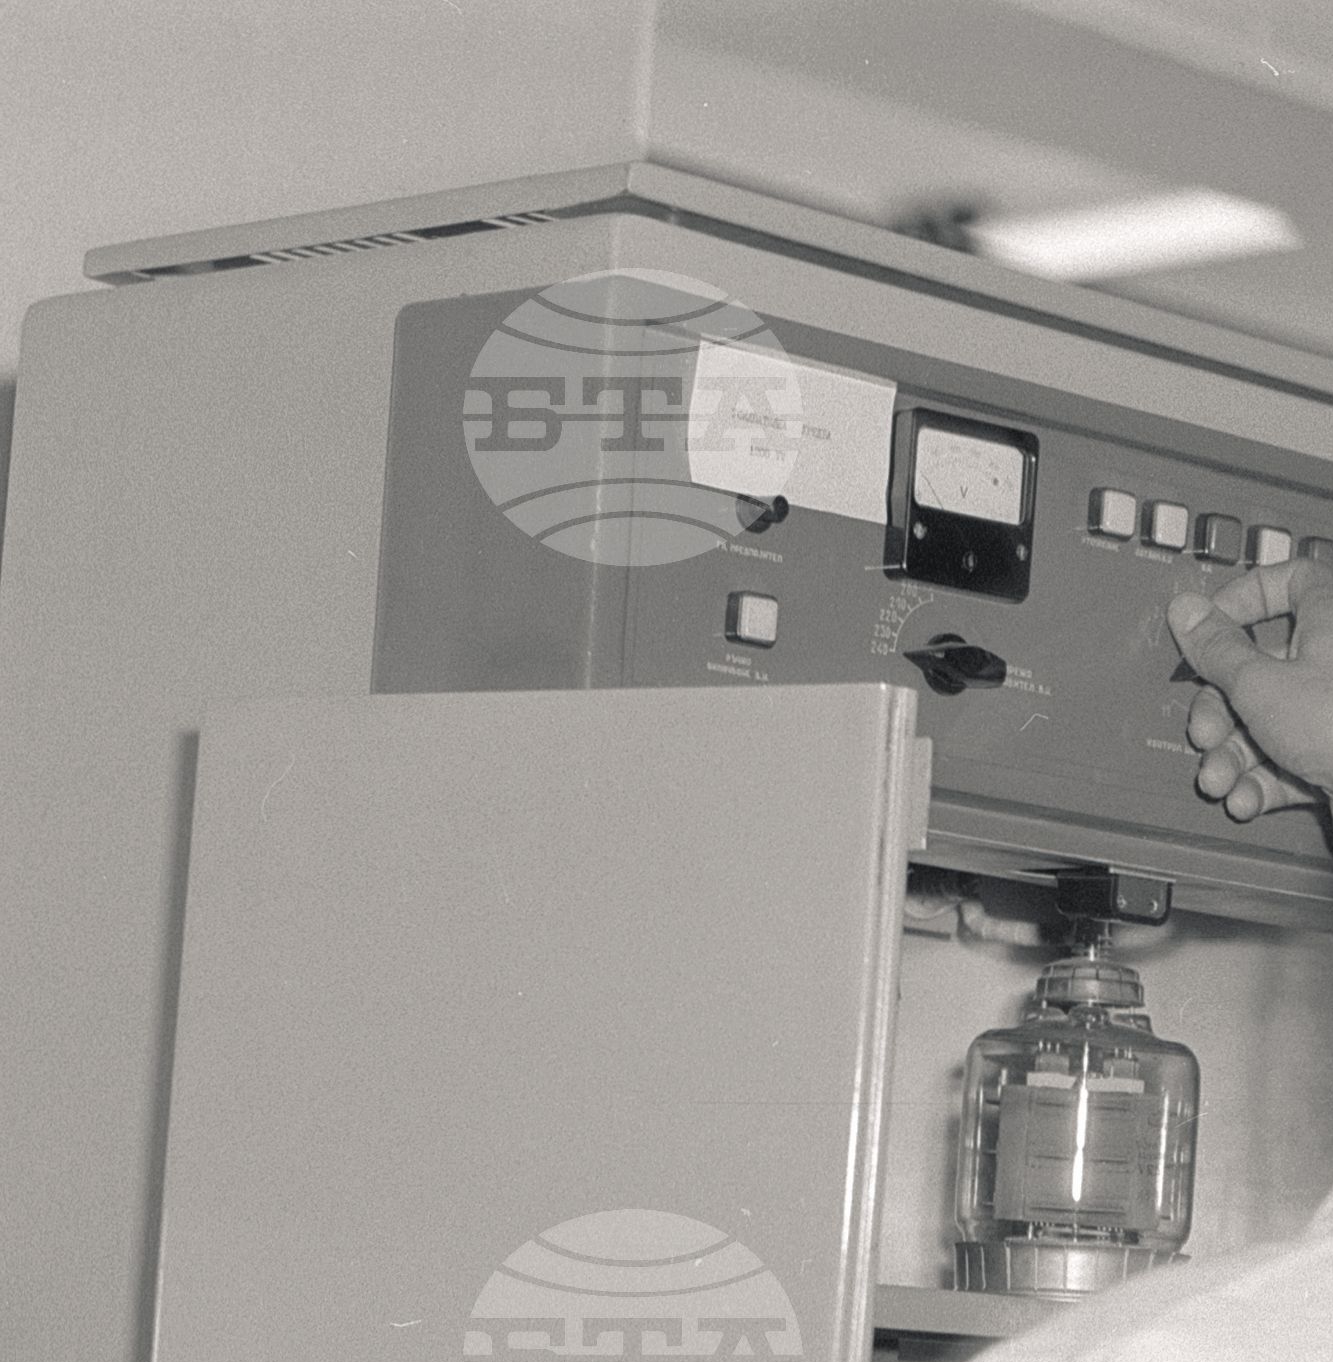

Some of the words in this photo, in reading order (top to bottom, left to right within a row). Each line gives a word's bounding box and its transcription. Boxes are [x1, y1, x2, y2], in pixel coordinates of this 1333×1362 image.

[879, 608, 898, 624] 220
[873, 623, 892, 639] 230
[870, 639, 889, 656] 240
